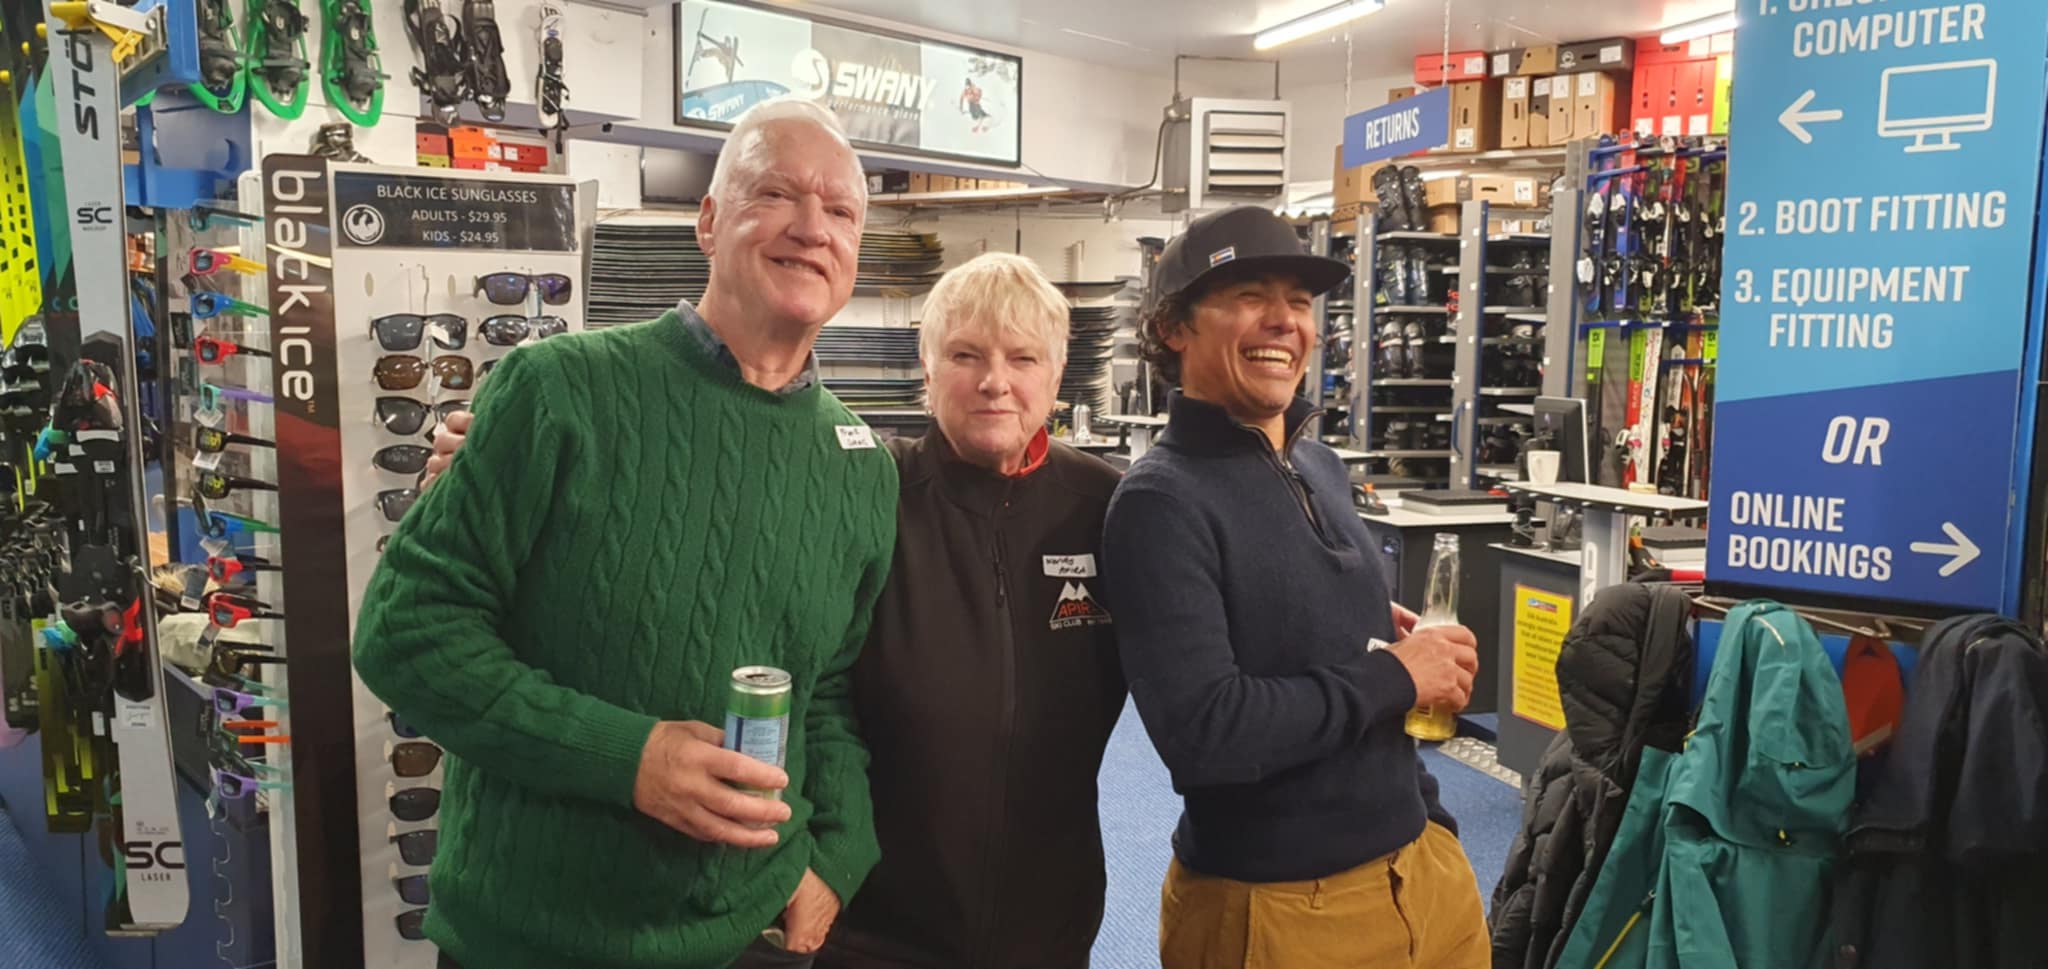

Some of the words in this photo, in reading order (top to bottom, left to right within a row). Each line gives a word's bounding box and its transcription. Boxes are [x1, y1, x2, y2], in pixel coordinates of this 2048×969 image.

[1793, 3, 1987, 58] COMPUTER
[832, 62, 936, 110] SWANY
[1366, 107, 1420, 150] RETURNS
[77, 207, 112, 224] SC
[377, 185, 422, 200] BLACK
[426, 187, 448, 201] ICE
[451, 189, 537, 204] SUNGLASSES
[1738, 201, 1765, 236] 2.
[1775, 197, 1863, 235] BOOT
[1870, 190, 2007, 232] FITTING
[411, 209, 459, 223] ADULTS
[468, 210, 508, 224] $29.95
[422, 230, 451, 242] KIDS
[460, 231, 500, 244] $24.95
[271, 170, 327, 315] black
[1734, 269, 1761, 303] 3.
[1771, 265, 1970, 307] EQUIPMENT
[1769, 312, 1895, 349] FITTING
[279, 327, 315, 401] ice
[1821, 415, 1891, 466] OR
[1730, 490, 1846, 533] ONLINE
[1727, 533, 1893, 582] BOOKINGS
[1058, 602, 1091, 618] APIR
[126, 841, 185, 869] SC
[141, 872, 172, 882] LASER
